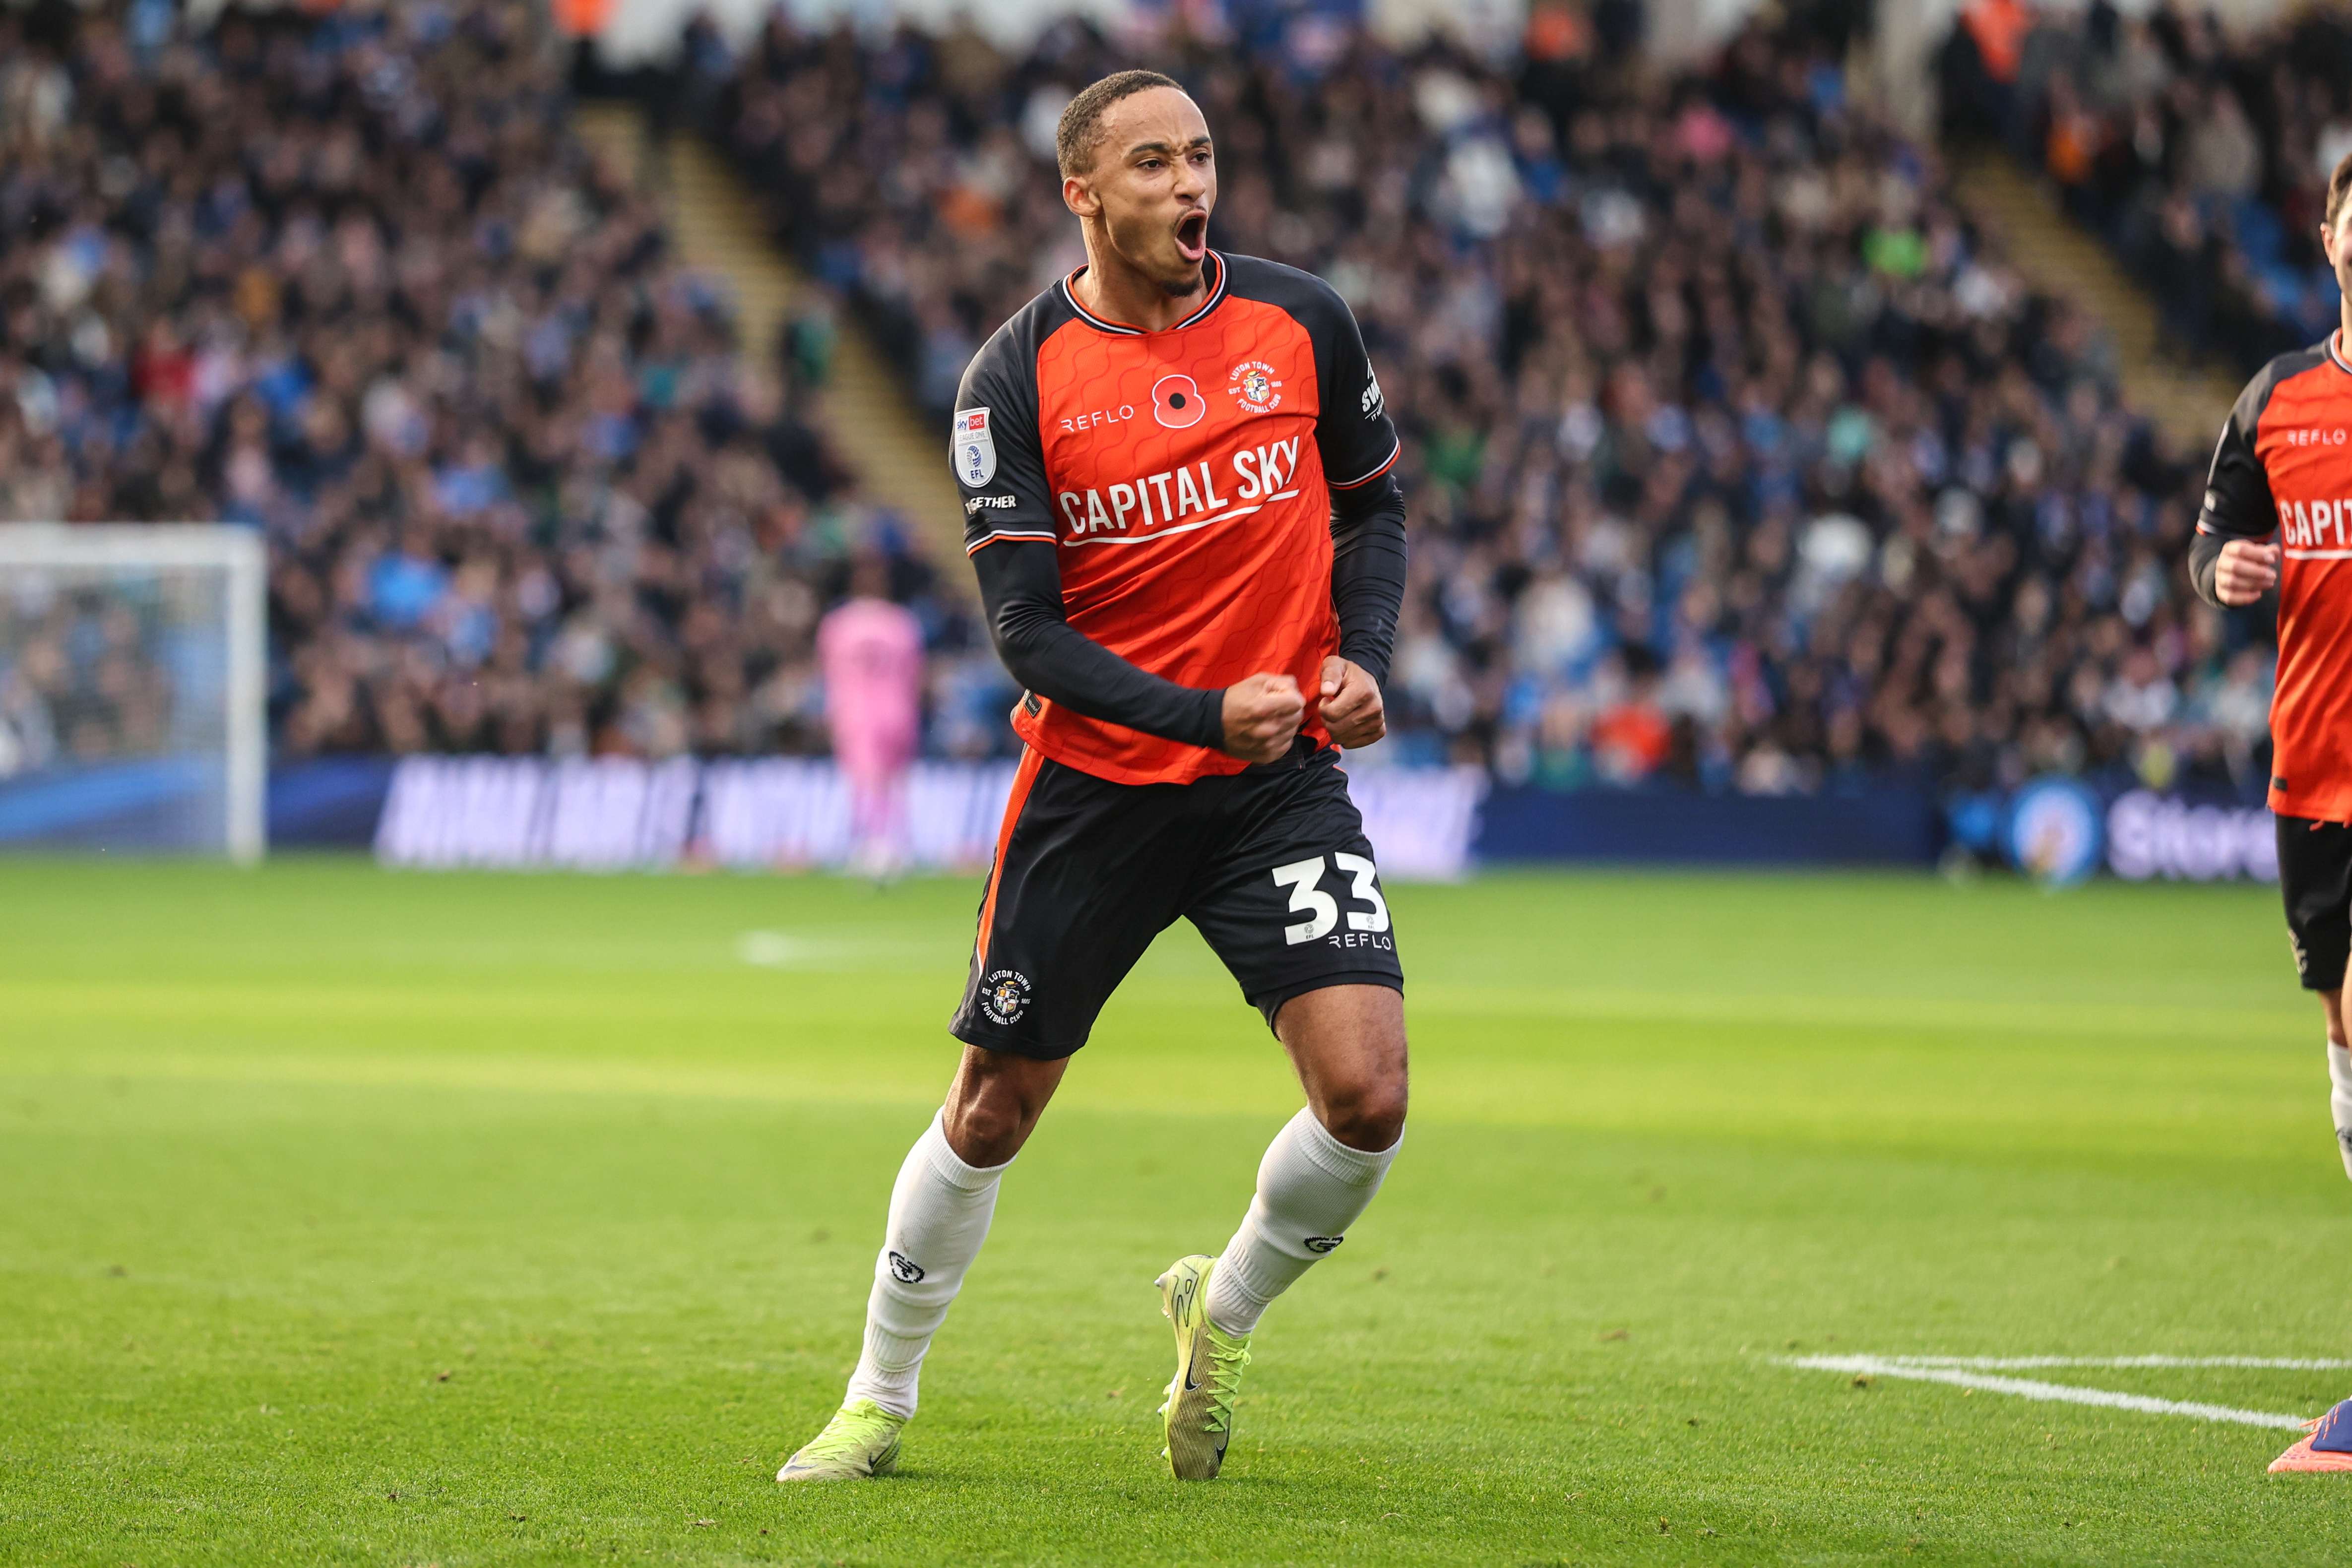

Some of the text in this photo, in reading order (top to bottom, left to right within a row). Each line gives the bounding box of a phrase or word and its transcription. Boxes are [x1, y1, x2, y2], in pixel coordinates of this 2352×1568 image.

[1230, 361, 1275, 381] LUTON TOWN
[1228, 386, 1241, 395] EST
[1236, 393, 1281, 413] FOOTBALL CLUB
[957, 415, 984, 431] sky bet
[1061, 405, 1134, 432] REFLO
[1371, 413, 1377, 422] IT
[958, 433, 974, 441] LEAGUE
[2288, 428, 2347, 446] REFLO
[970, 469, 984, 479] EFL
[1059, 435, 1299, 534] CAPITAL SKY
[1271, 851, 1389, 945] 33
[1329, 933, 1391, 950] REFLO
[988, 970, 1032, 992] LUTON TOWN
[982, 987, 992, 996] EST
[981, 1002, 1024, 1025] FOOTBALL CLUB
